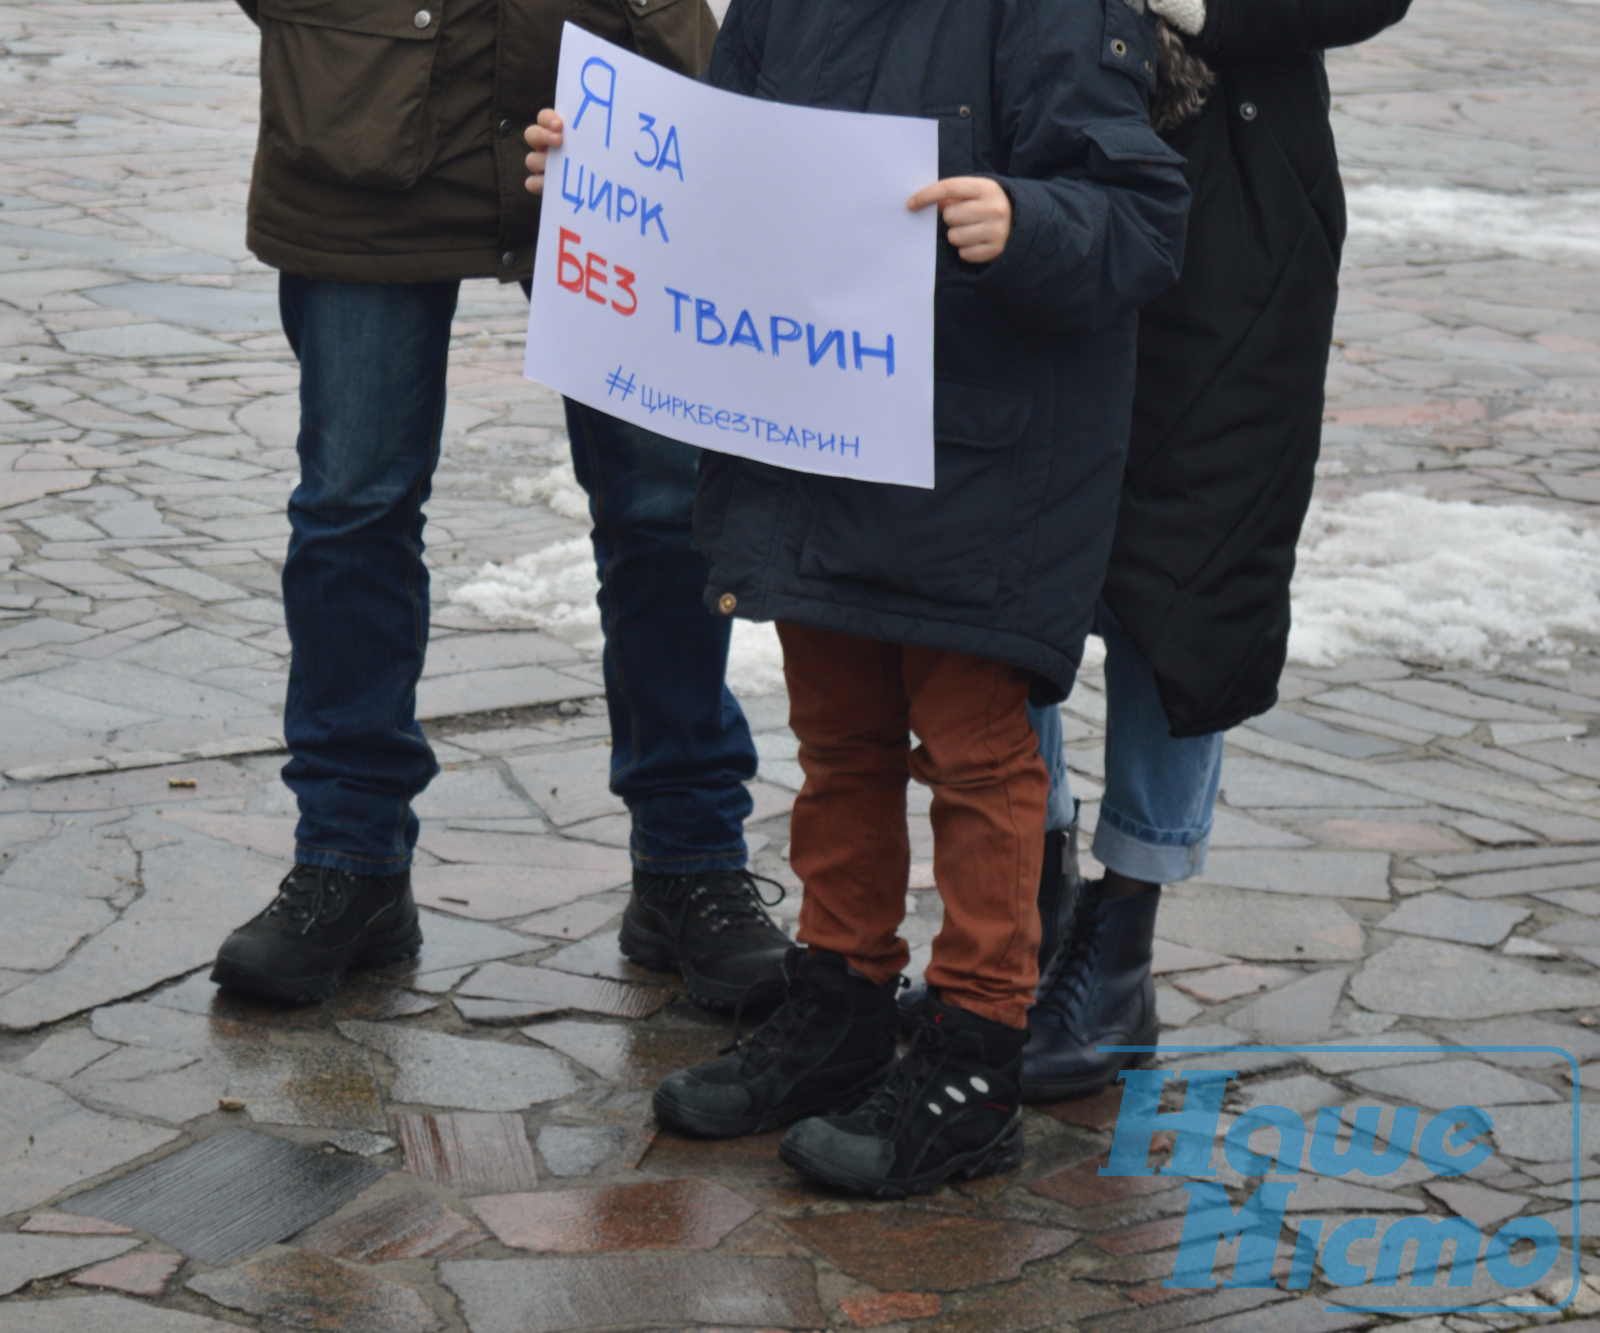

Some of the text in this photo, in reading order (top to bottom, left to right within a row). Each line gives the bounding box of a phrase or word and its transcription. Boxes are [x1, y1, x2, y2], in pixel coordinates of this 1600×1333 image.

[572, 55, 685, 182] Я ЗА
[561, 156, 670, 243] ЦИРК
[556, 226, 897, 378] БЕЗ ТВАРИН
